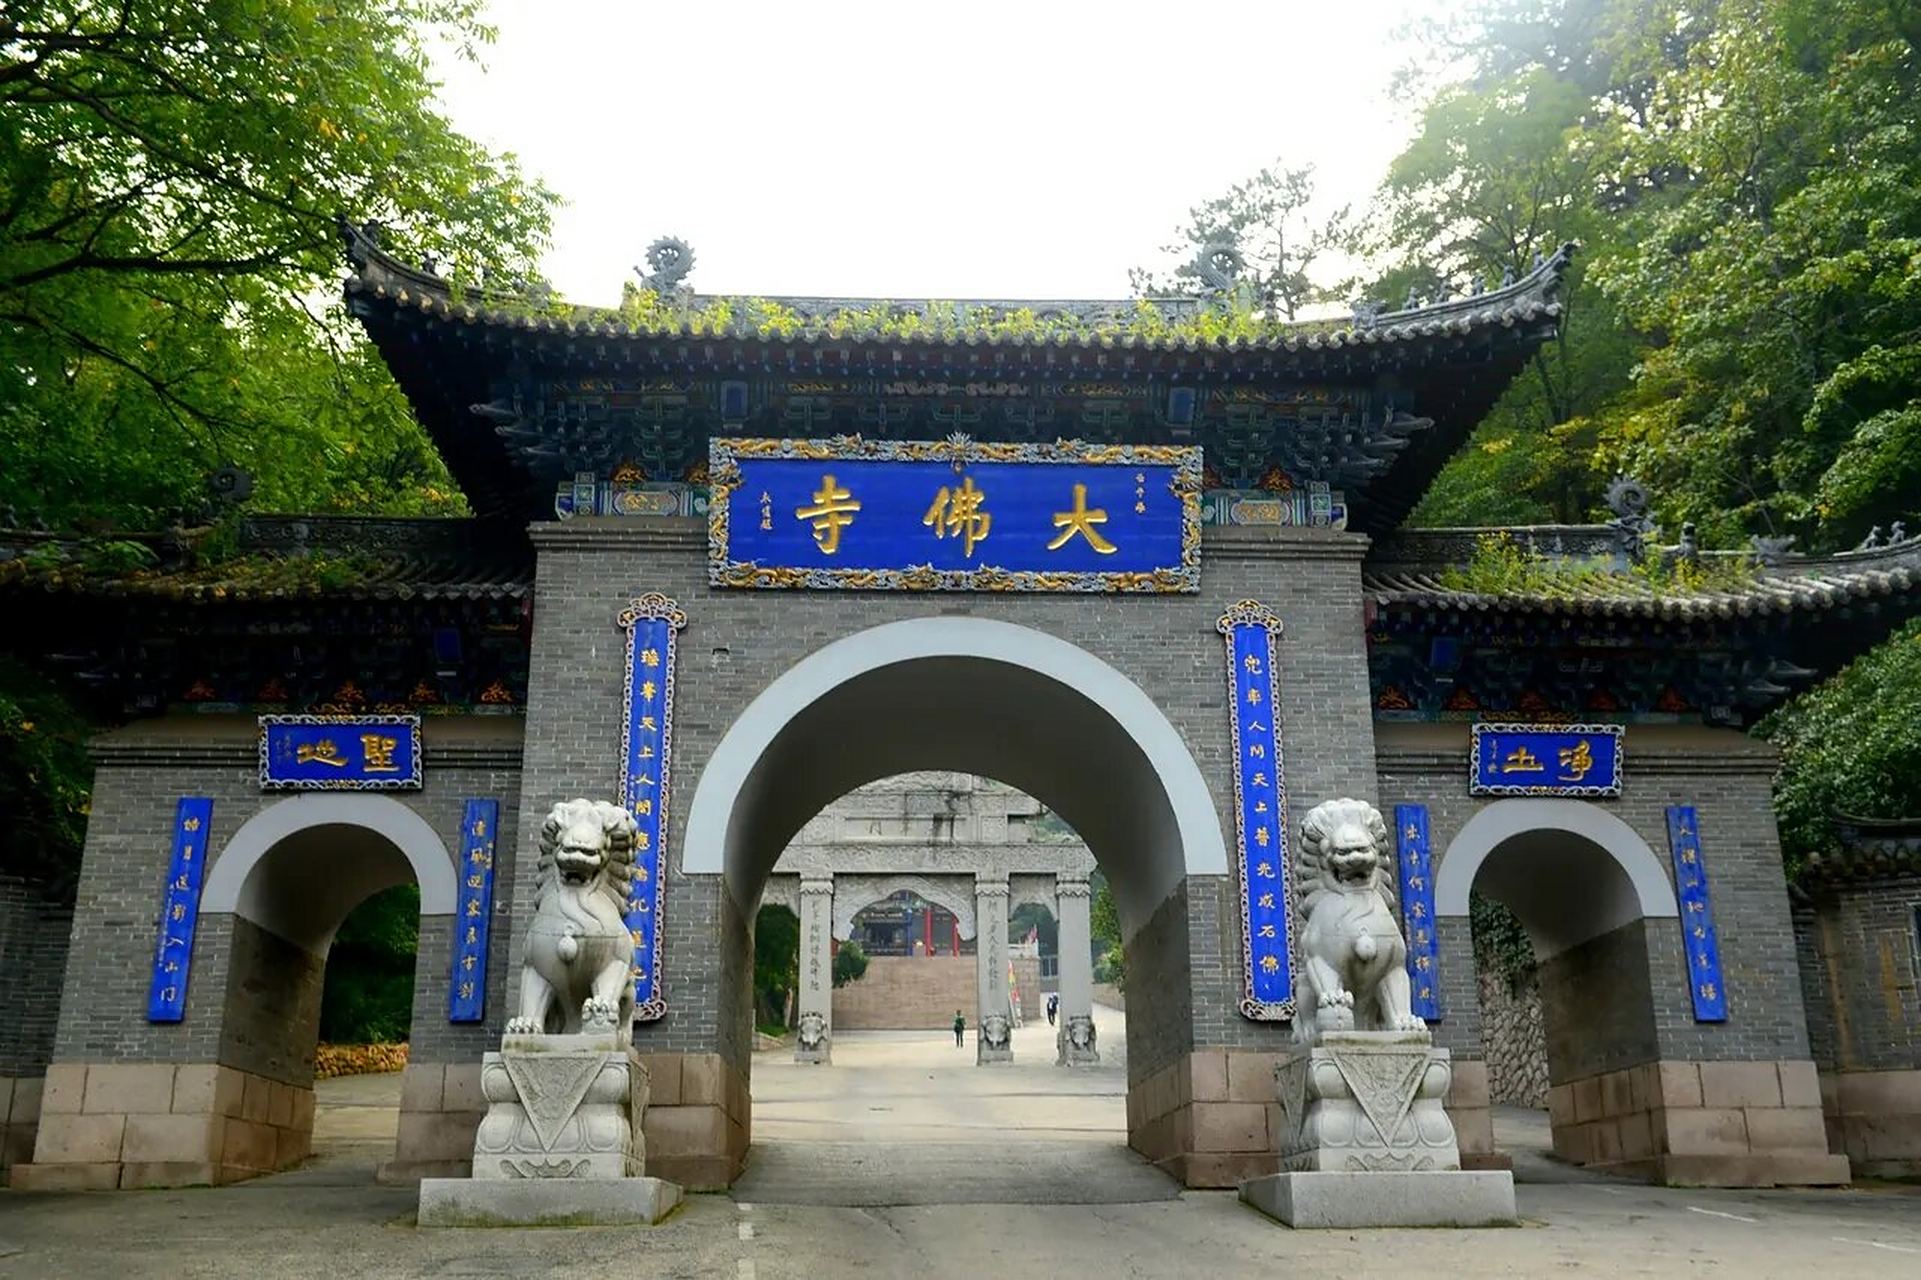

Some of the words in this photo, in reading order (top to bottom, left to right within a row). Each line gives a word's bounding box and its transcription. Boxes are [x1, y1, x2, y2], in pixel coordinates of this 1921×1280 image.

[795, 474, 1118, 559] 大佛寺
[297, 734, 400, 773] 聖地
